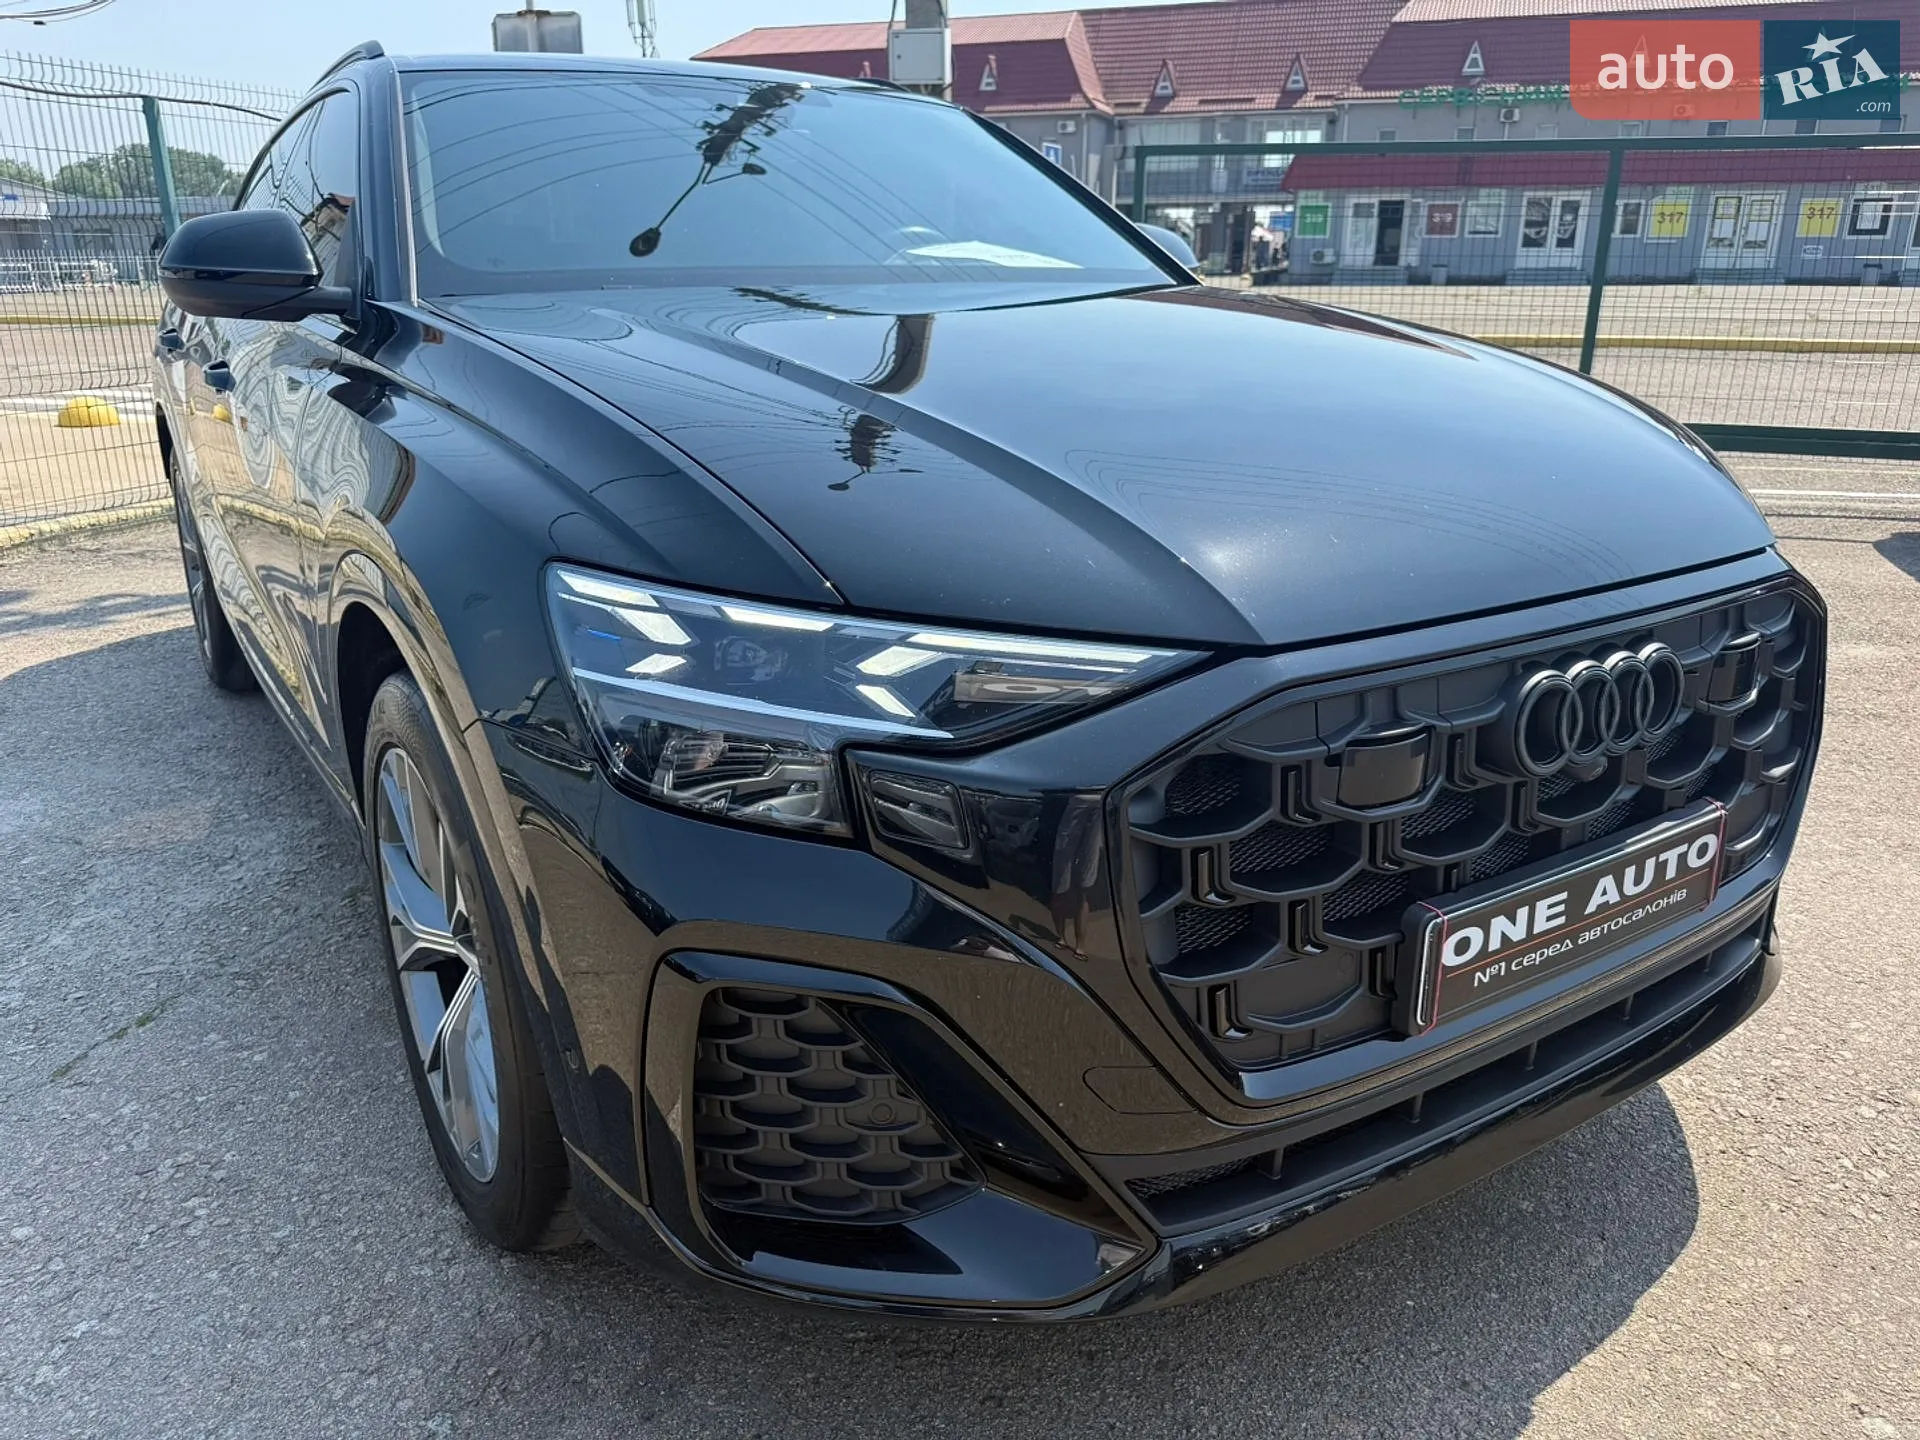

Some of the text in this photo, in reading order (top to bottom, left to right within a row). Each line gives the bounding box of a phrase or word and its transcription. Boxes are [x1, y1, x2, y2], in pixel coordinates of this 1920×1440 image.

[1657, 211, 1684, 224] 317
[1806, 206, 1835, 220] 317
[1441, 833, 1719, 967] ONE AUTO
[1511, 939, 1574, 972] серед
[1578, 889, 1688, 945] автосалонів
